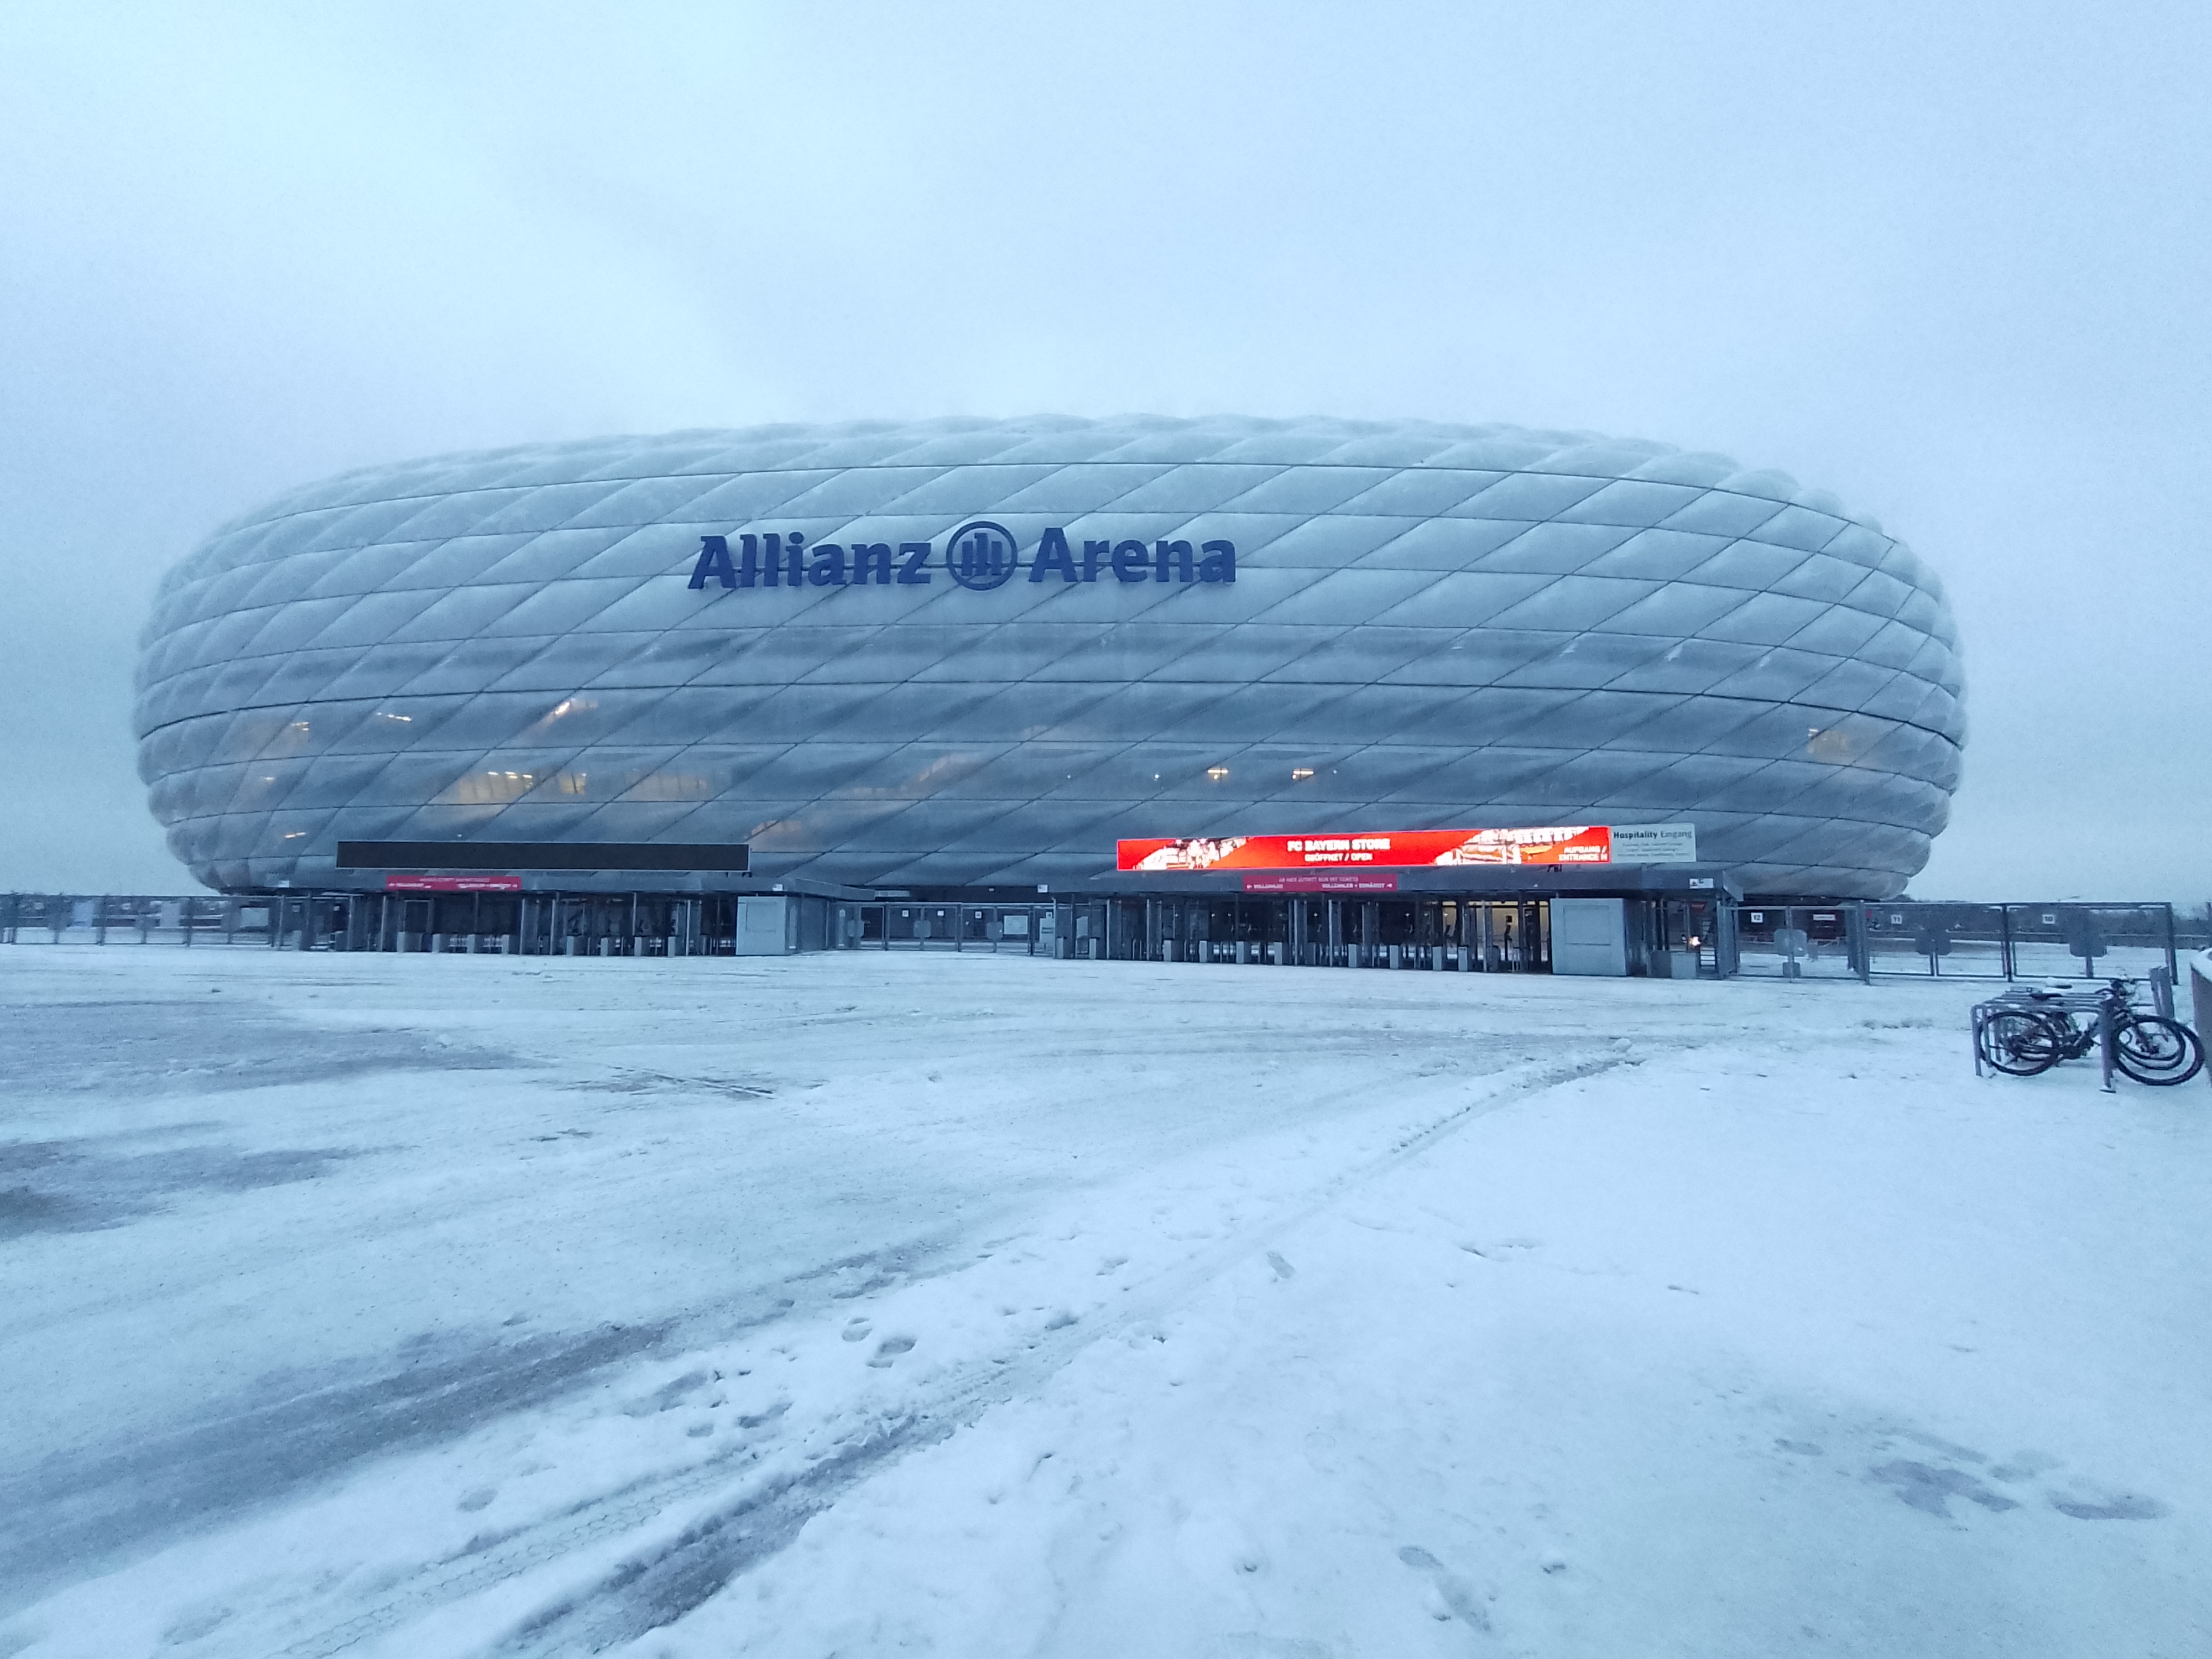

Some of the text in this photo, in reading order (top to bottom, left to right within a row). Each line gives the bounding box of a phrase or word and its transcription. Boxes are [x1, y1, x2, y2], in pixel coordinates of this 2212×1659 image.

[688, 528, 1237, 589] Allianz Arena
[1613, 831, 1658, 839] Hospitality
[1287, 838, 1391, 852] FC BAYERN STORE
[1351, 853, 1373, 861] OPEN
